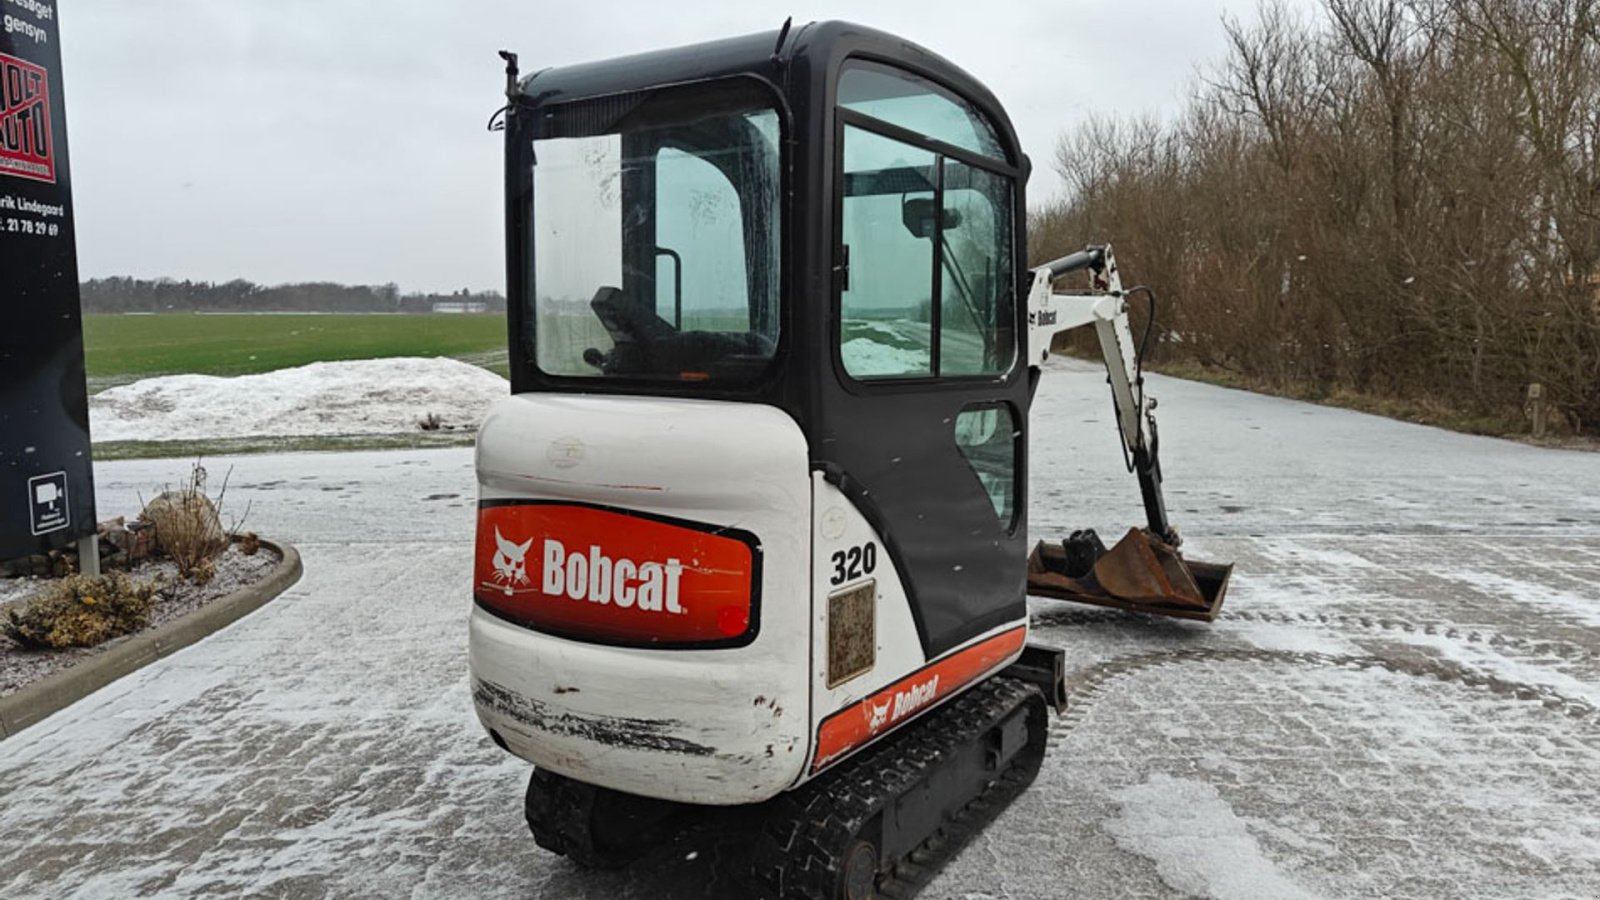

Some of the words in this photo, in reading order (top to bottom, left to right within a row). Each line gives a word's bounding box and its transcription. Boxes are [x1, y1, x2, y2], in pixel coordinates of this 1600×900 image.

[4, 14, 47, 43] gensyn
[0, 195, 16, 209] rik
[17, 197, 64, 217] Lindegaard
[6, 218, 19, 232] 21
[20, 219, 33, 234] 78
[35, 221, 46, 235] 29
[1037, 310, 1057, 327] Bobcat
[542, 539, 683, 614] Bobcat
[830, 542, 877, 586] 320
[891, 674, 940, 721] Bobcat
